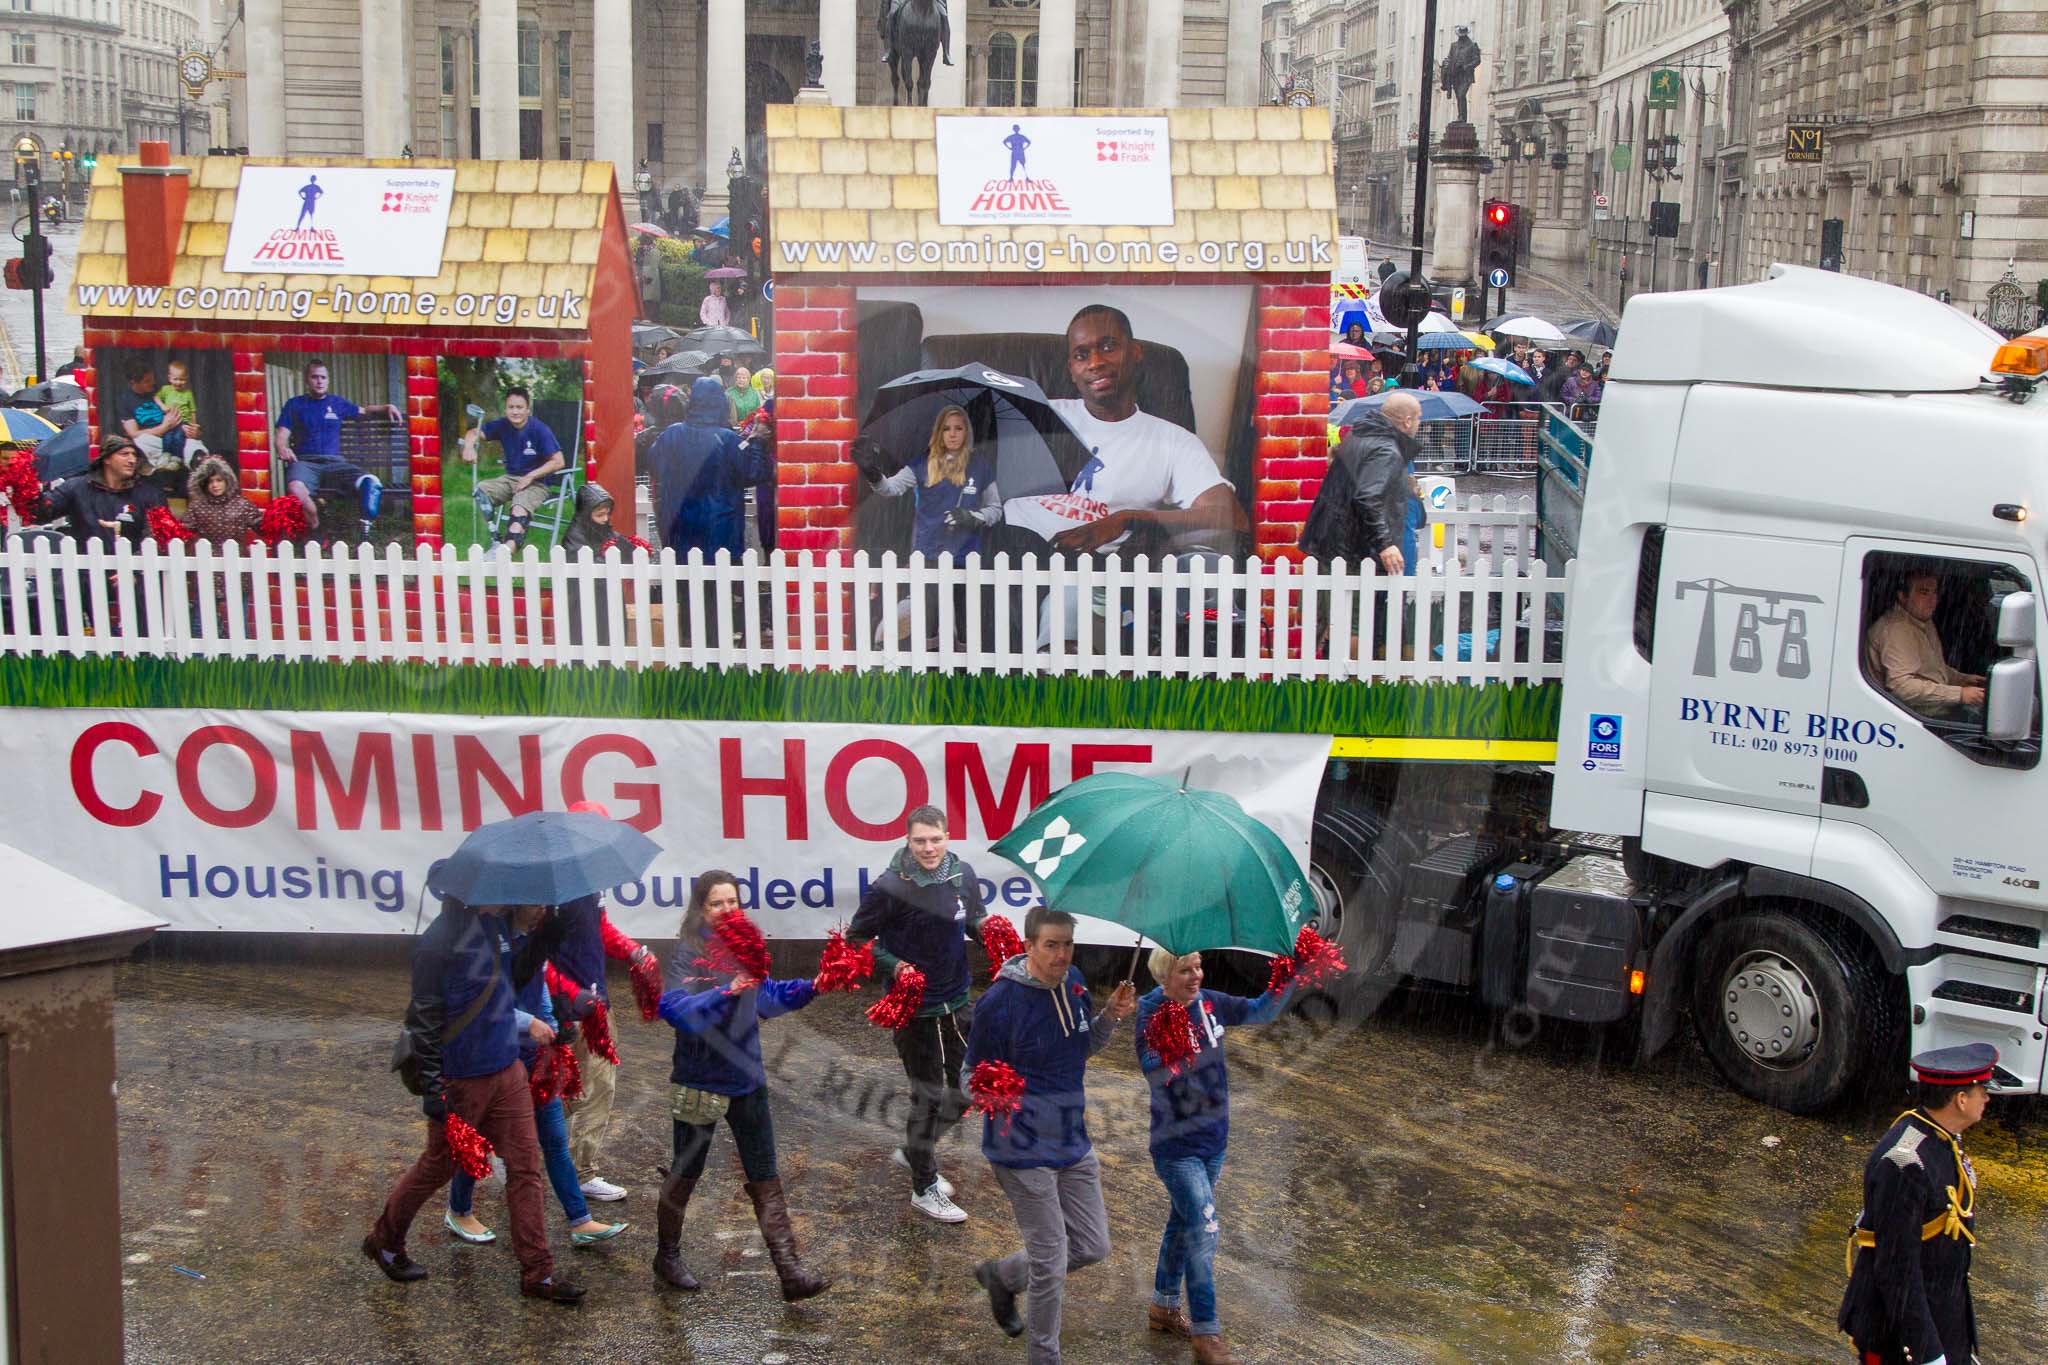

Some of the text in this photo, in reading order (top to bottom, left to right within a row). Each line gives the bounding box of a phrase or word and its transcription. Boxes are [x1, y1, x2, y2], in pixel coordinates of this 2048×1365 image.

[1121, 141, 1155, 152] Knight
[1121, 153, 1150, 162] Frank
[1787, 152, 1819, 160] CORNHILL
[984, 179, 1056, 192] COMING
[405, 193, 439, 204] Knight
[970, 192, 1070, 211] HOME
[404, 204, 431, 213] Frank
[270, 228, 337, 241] COMING
[253, 242, 345, 261] HOME
[781, 234, 1332, 270] www.coming-home.org.uk
[78, 282, 581, 323] www.coming-home.org.uk
[1680, 697, 1904, 749] BYRNE BROS.
[1591, 743, 1618, 753] FORS
[1710, 731, 1857, 763] TEL: 020 8973 0100
[70, 721, 662, 841] COMING
[159, 855, 403, 912] Housing
